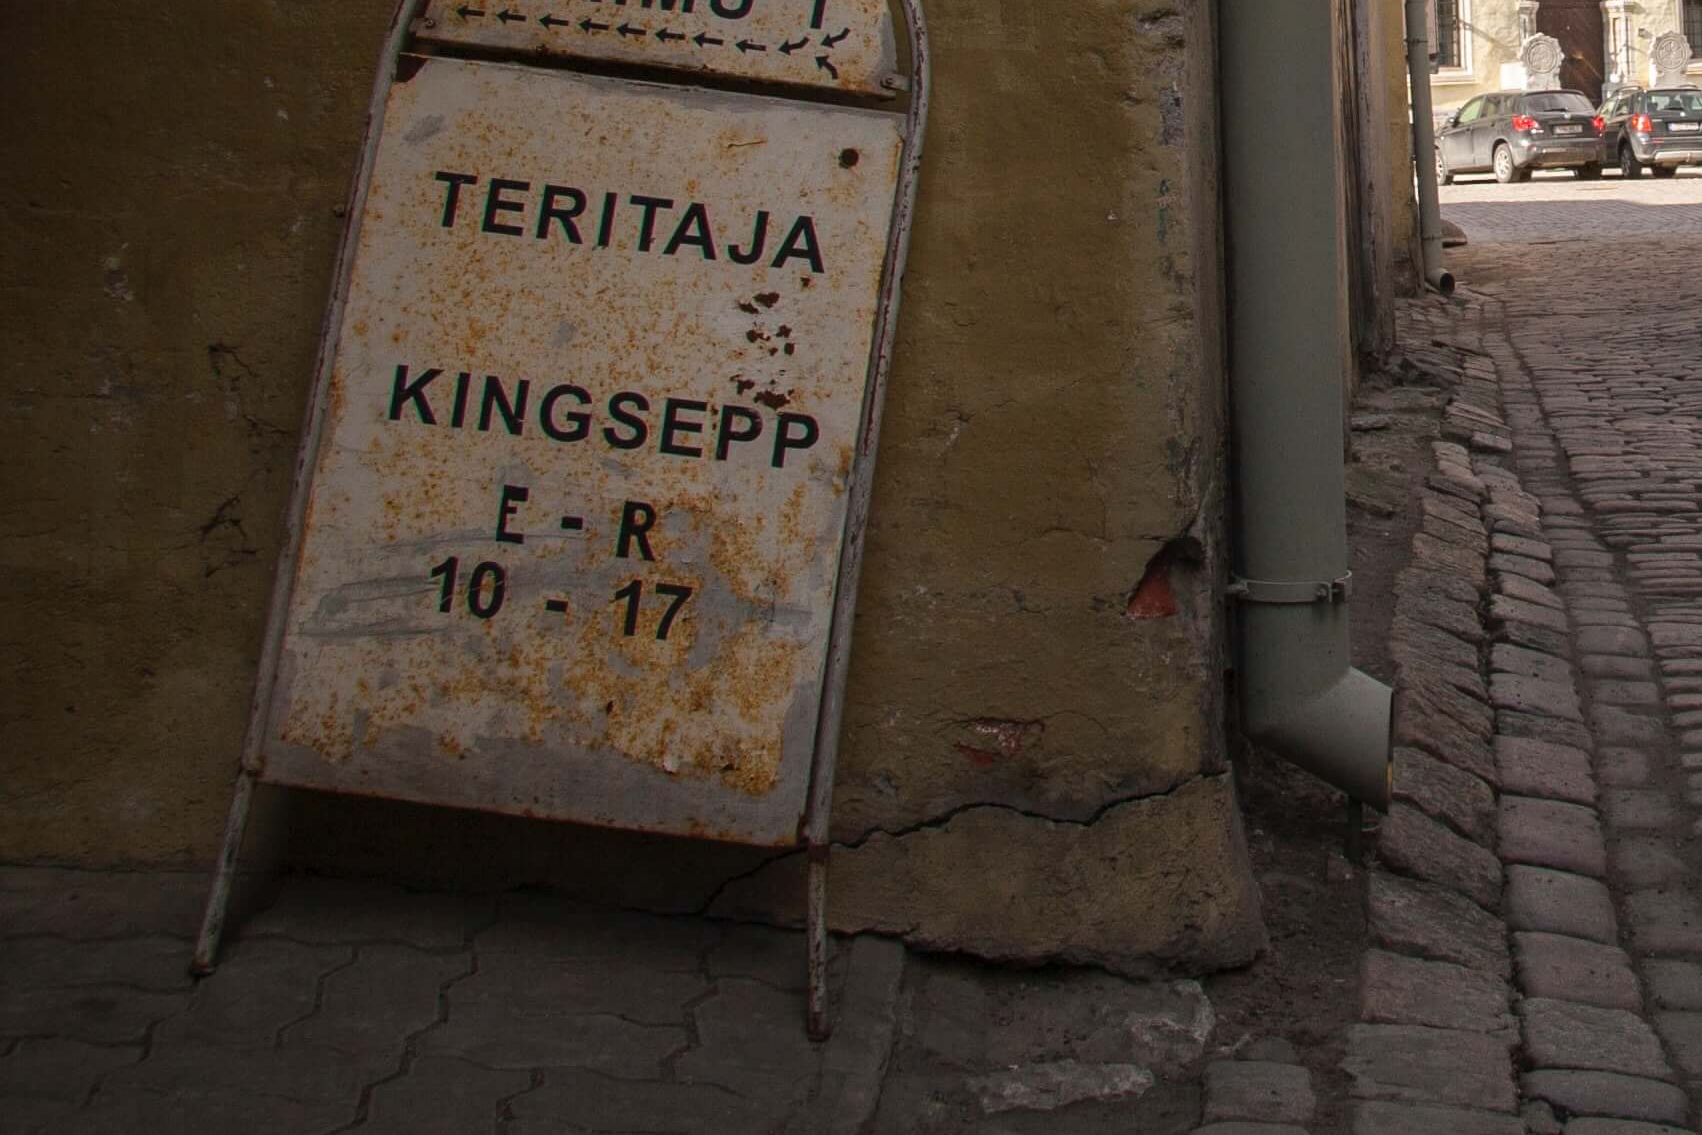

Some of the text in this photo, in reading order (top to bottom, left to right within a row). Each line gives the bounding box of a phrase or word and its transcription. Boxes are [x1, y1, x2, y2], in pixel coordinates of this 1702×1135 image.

[433, 169, 826, 275] TERITAJA
[387, 363, 821, 469] KINGSEPP
[494, 483, 530, 546] E
[614, 499, 658, 564] R
[429, 555, 508, 624] 10
[609, 577, 694, 642] 17
